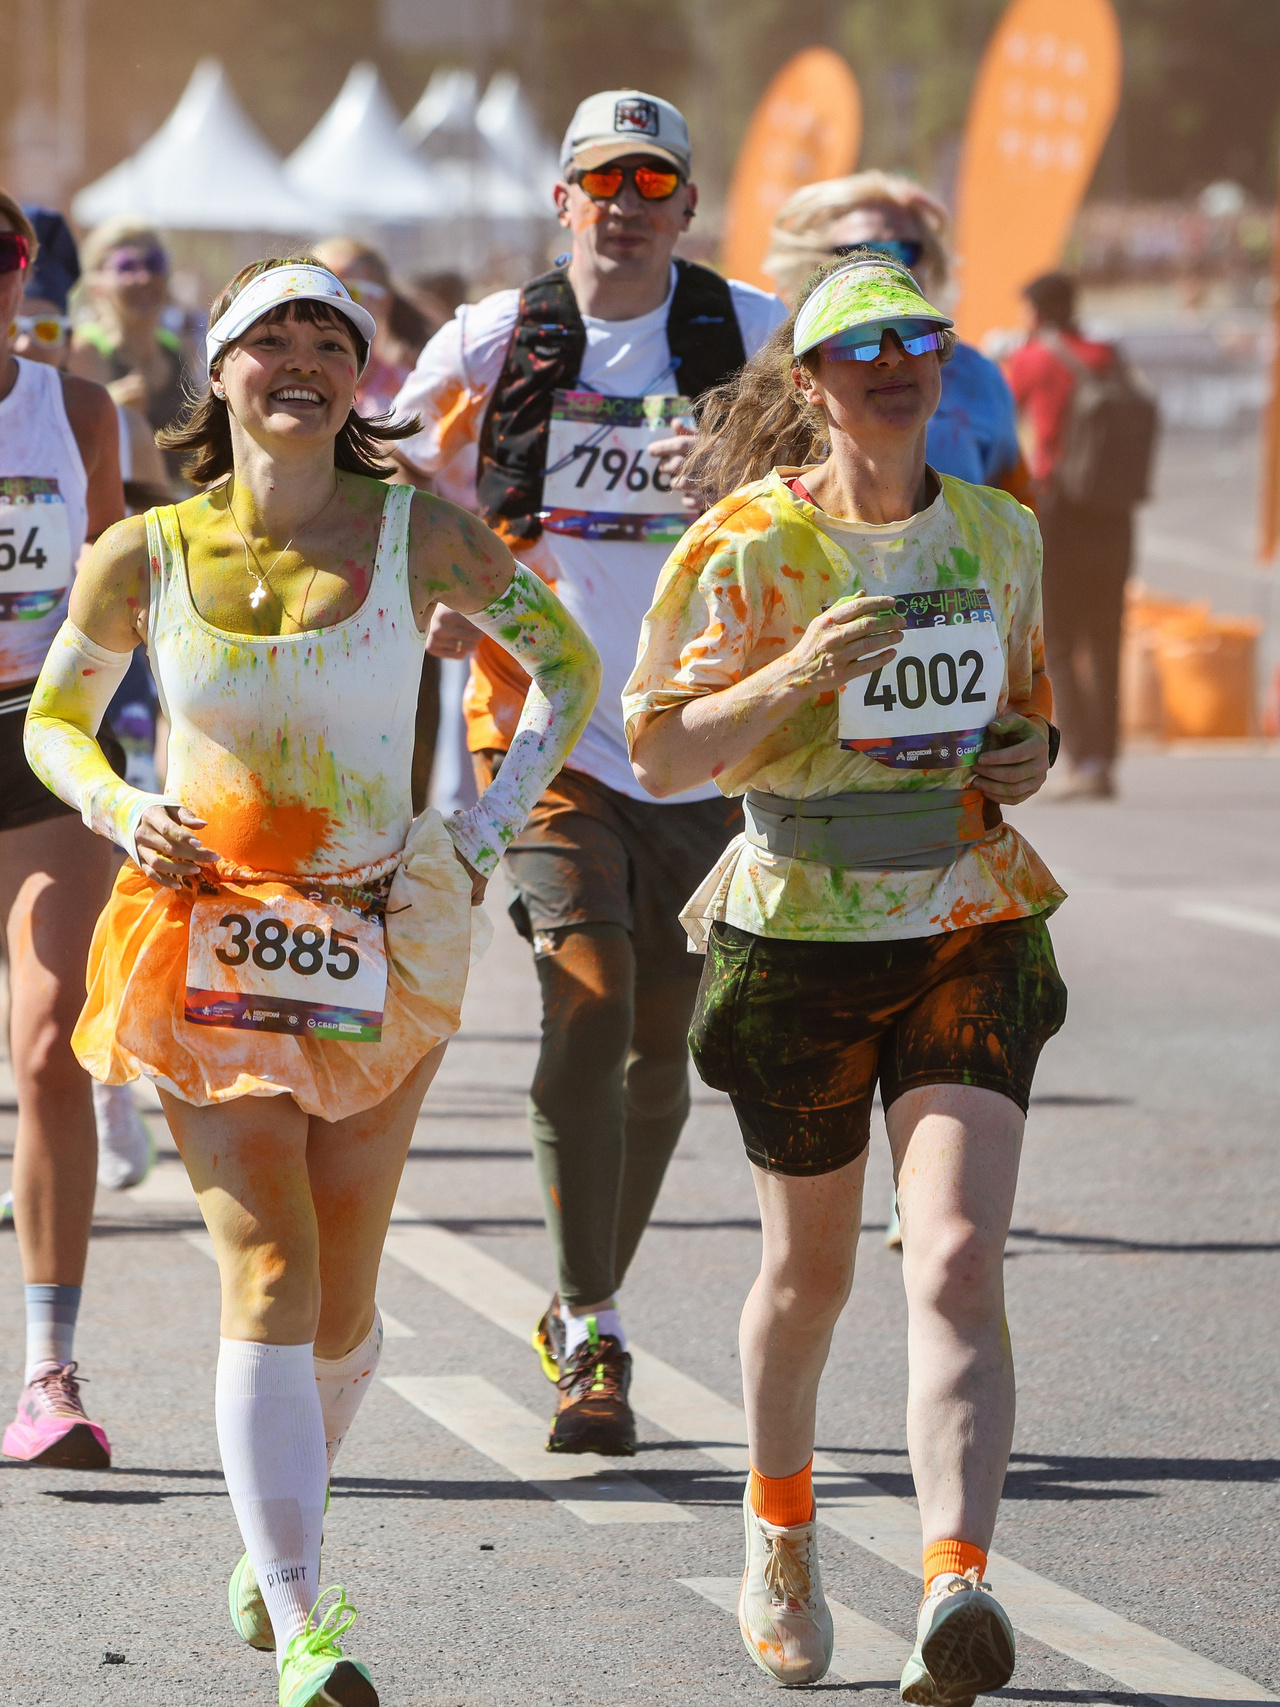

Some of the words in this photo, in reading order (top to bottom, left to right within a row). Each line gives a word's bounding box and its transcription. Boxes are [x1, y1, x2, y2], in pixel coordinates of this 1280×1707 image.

[863, 650, 987, 712] 4002
[215, 913, 360, 981] 3885
[317, 1021, 338, 1029] СБЕР
